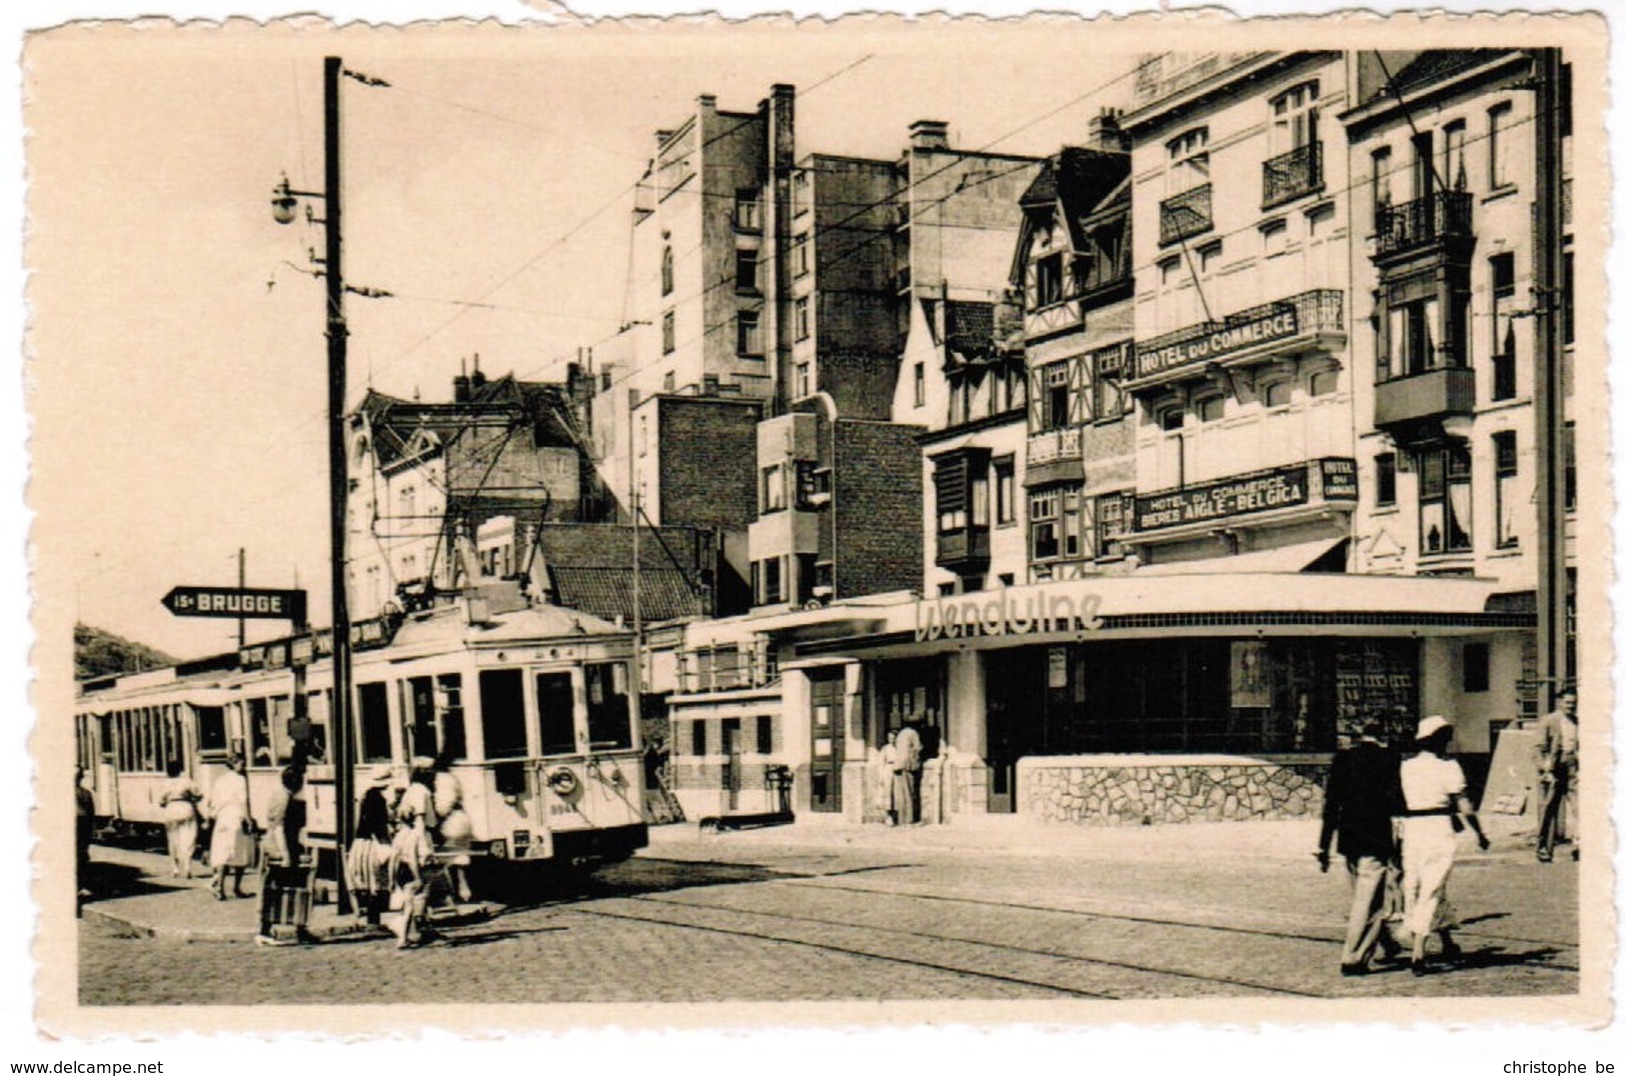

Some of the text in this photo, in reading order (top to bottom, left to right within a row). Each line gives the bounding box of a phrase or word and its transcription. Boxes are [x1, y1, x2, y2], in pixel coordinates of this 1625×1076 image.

[1139, 311, 1295, 374] HOTEL DU COMMERCE
[1150, 475, 1287, 512] HOTEL DU COMMERCE
[197, 593, 282, 613] BRUGGE
[914, 587, 1104, 642] Wenduine
